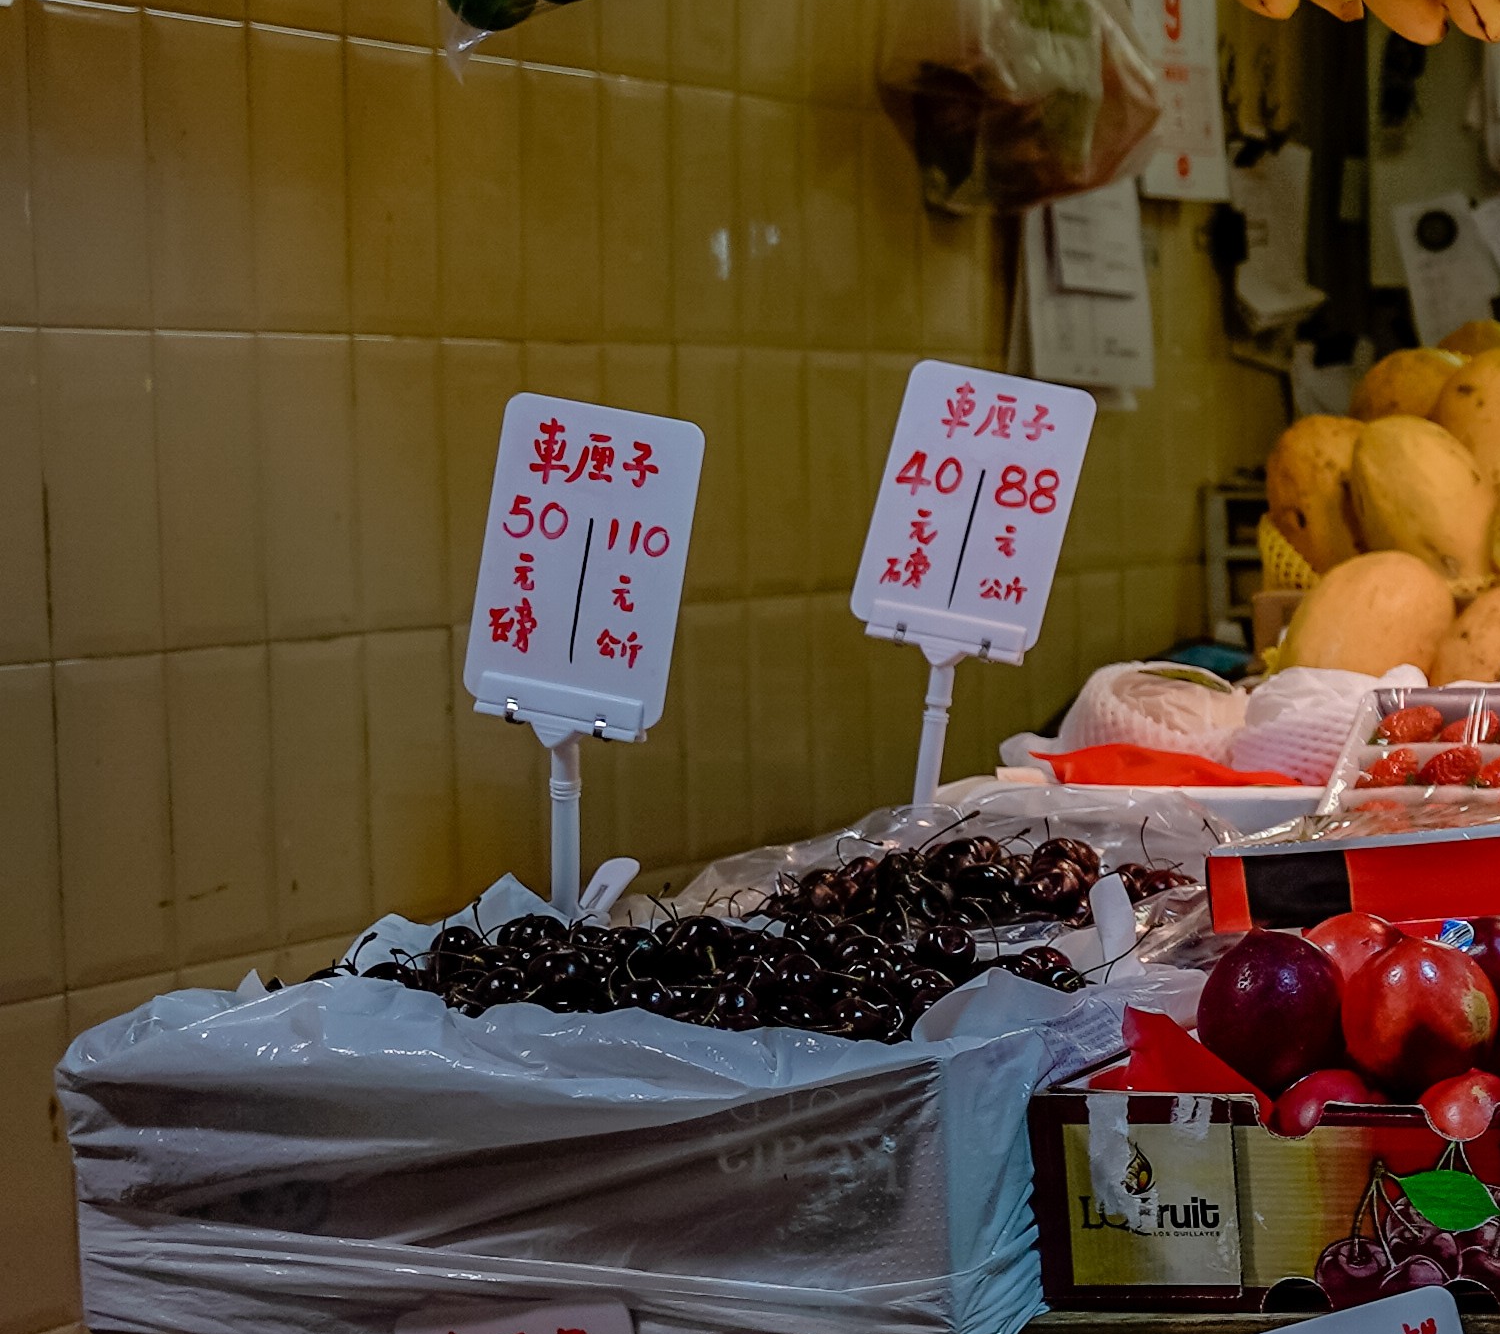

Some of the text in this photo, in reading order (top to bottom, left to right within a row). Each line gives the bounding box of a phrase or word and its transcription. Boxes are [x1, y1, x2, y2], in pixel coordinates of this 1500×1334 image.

[940, 382, 1056, 442] 車厘子
[529, 418, 659, 488] 車厘子
[895, 450, 1060, 515] 40 88
[503, 494, 670, 558] 50 110
